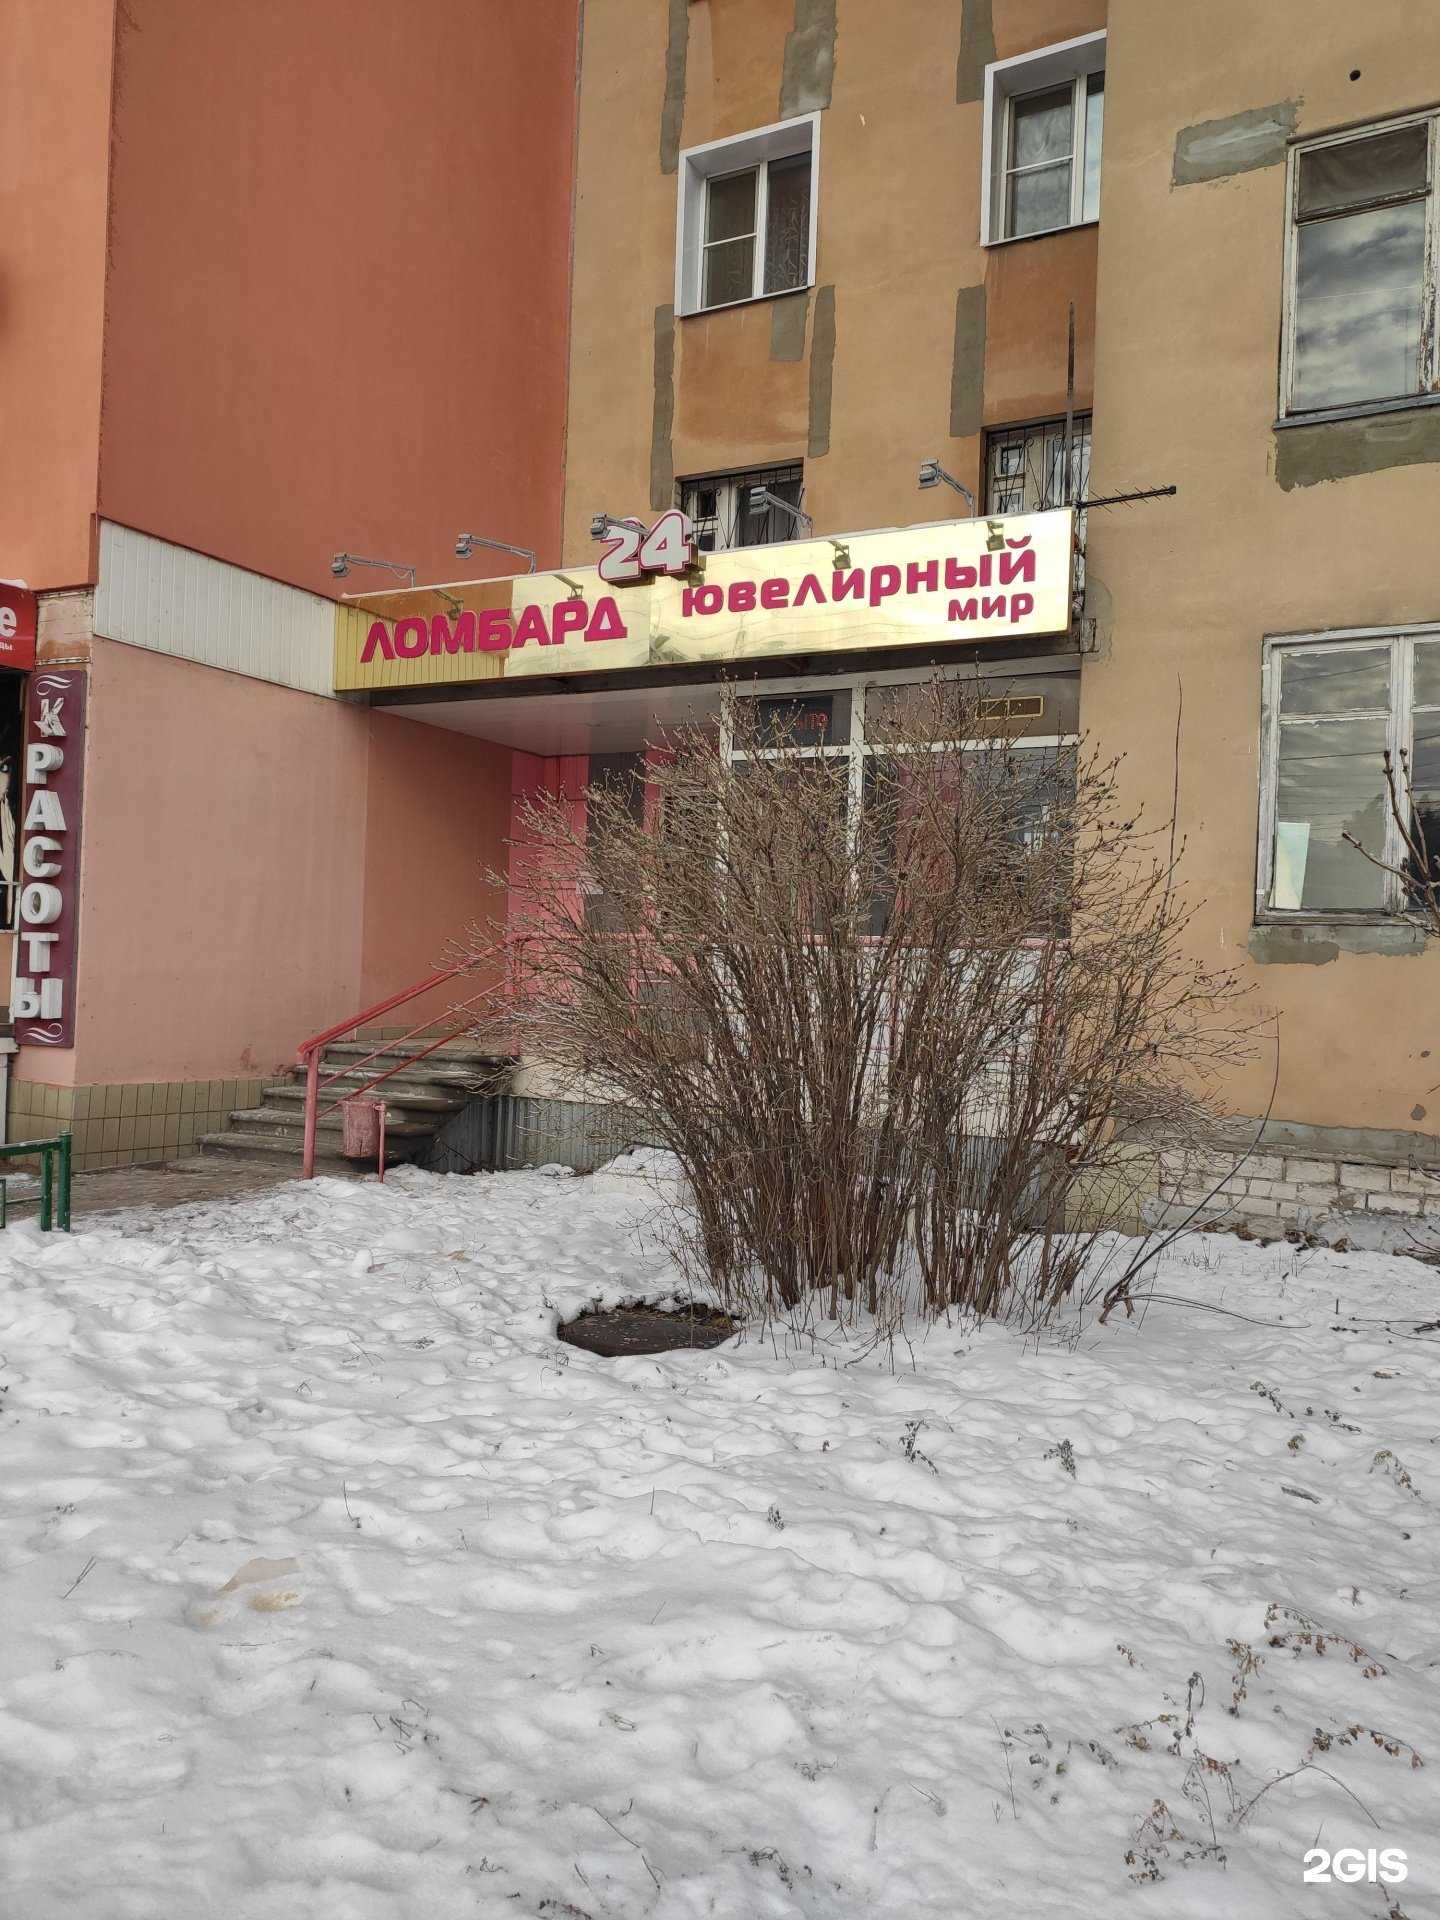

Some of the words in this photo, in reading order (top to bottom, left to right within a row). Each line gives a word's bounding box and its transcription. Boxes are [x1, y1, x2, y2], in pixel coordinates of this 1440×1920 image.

[598, 509, 692, 582] 24
[682, 535, 1036, 618] ювелирный
[359, 596, 629, 664] ЛОМБАРД
[947, 593, 1034, 624] мир
[14, 697, 67, 1019] КРАСОТЫ
